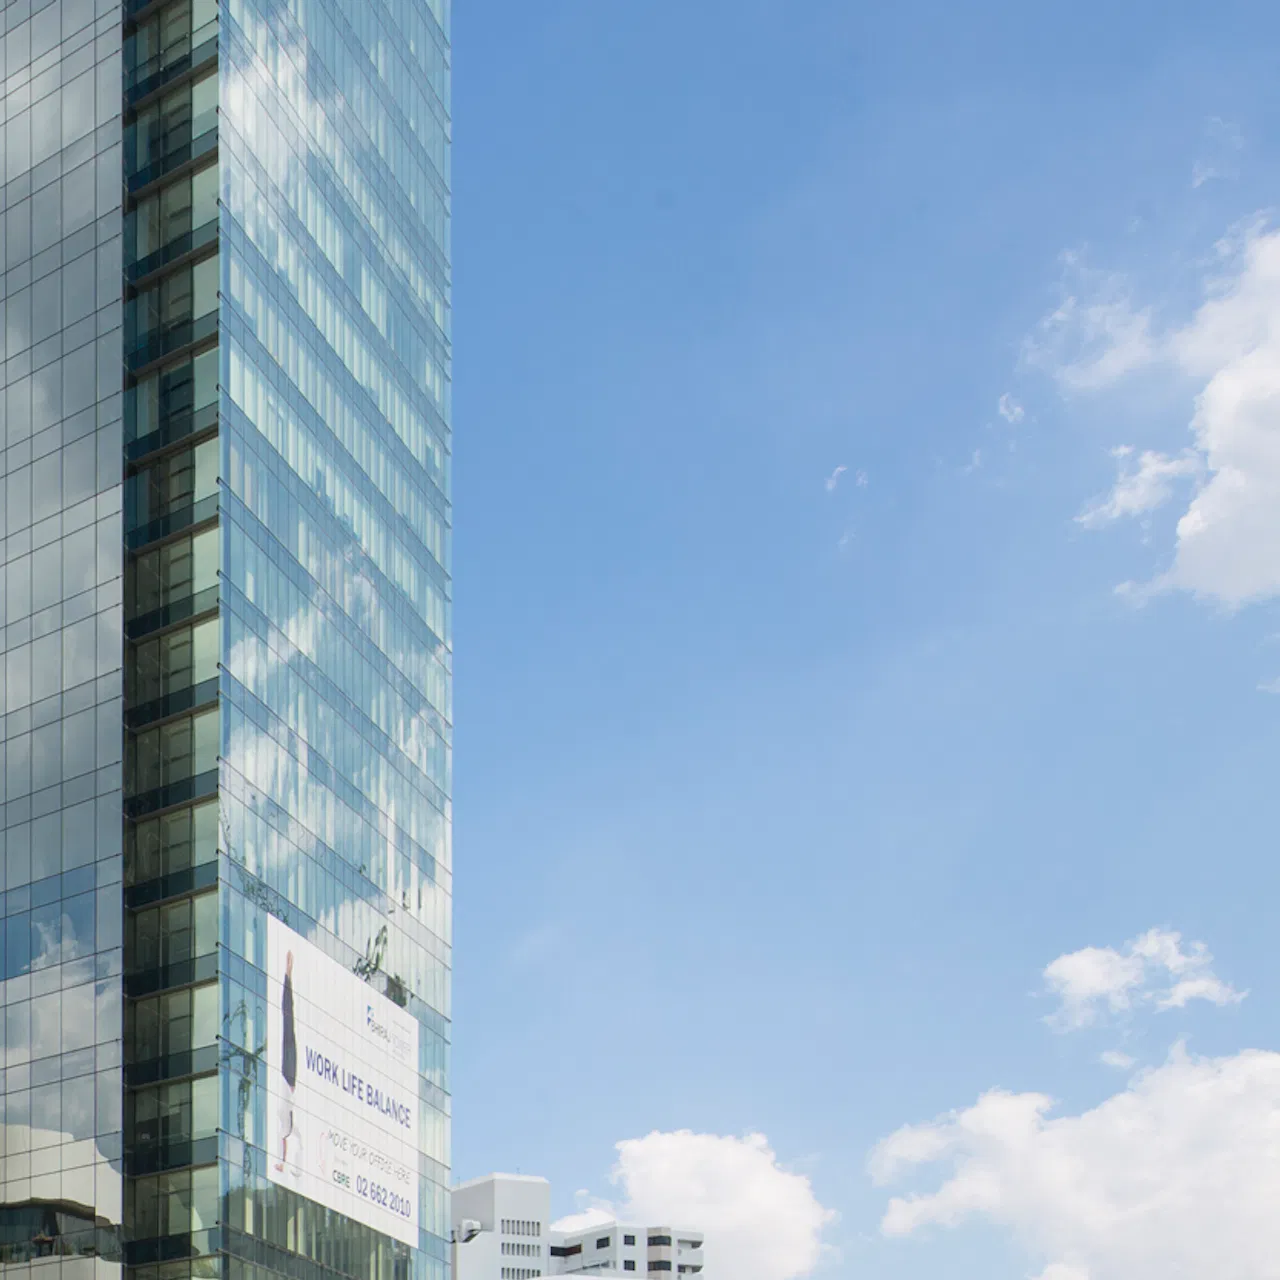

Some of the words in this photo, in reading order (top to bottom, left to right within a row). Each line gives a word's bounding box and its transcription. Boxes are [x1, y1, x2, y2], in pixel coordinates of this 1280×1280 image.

[305, 1045, 339, 1086] WORK
[342, 1068, 364, 1101] LIFE
[366, 1083, 411, 1129] BALANCE
[332, 1169, 351, 1189] CBRE
[356, 1174, 368, 1197] 02
[370, 1181, 388, 1207] 662
[389, 1191, 411, 1218] 2010
